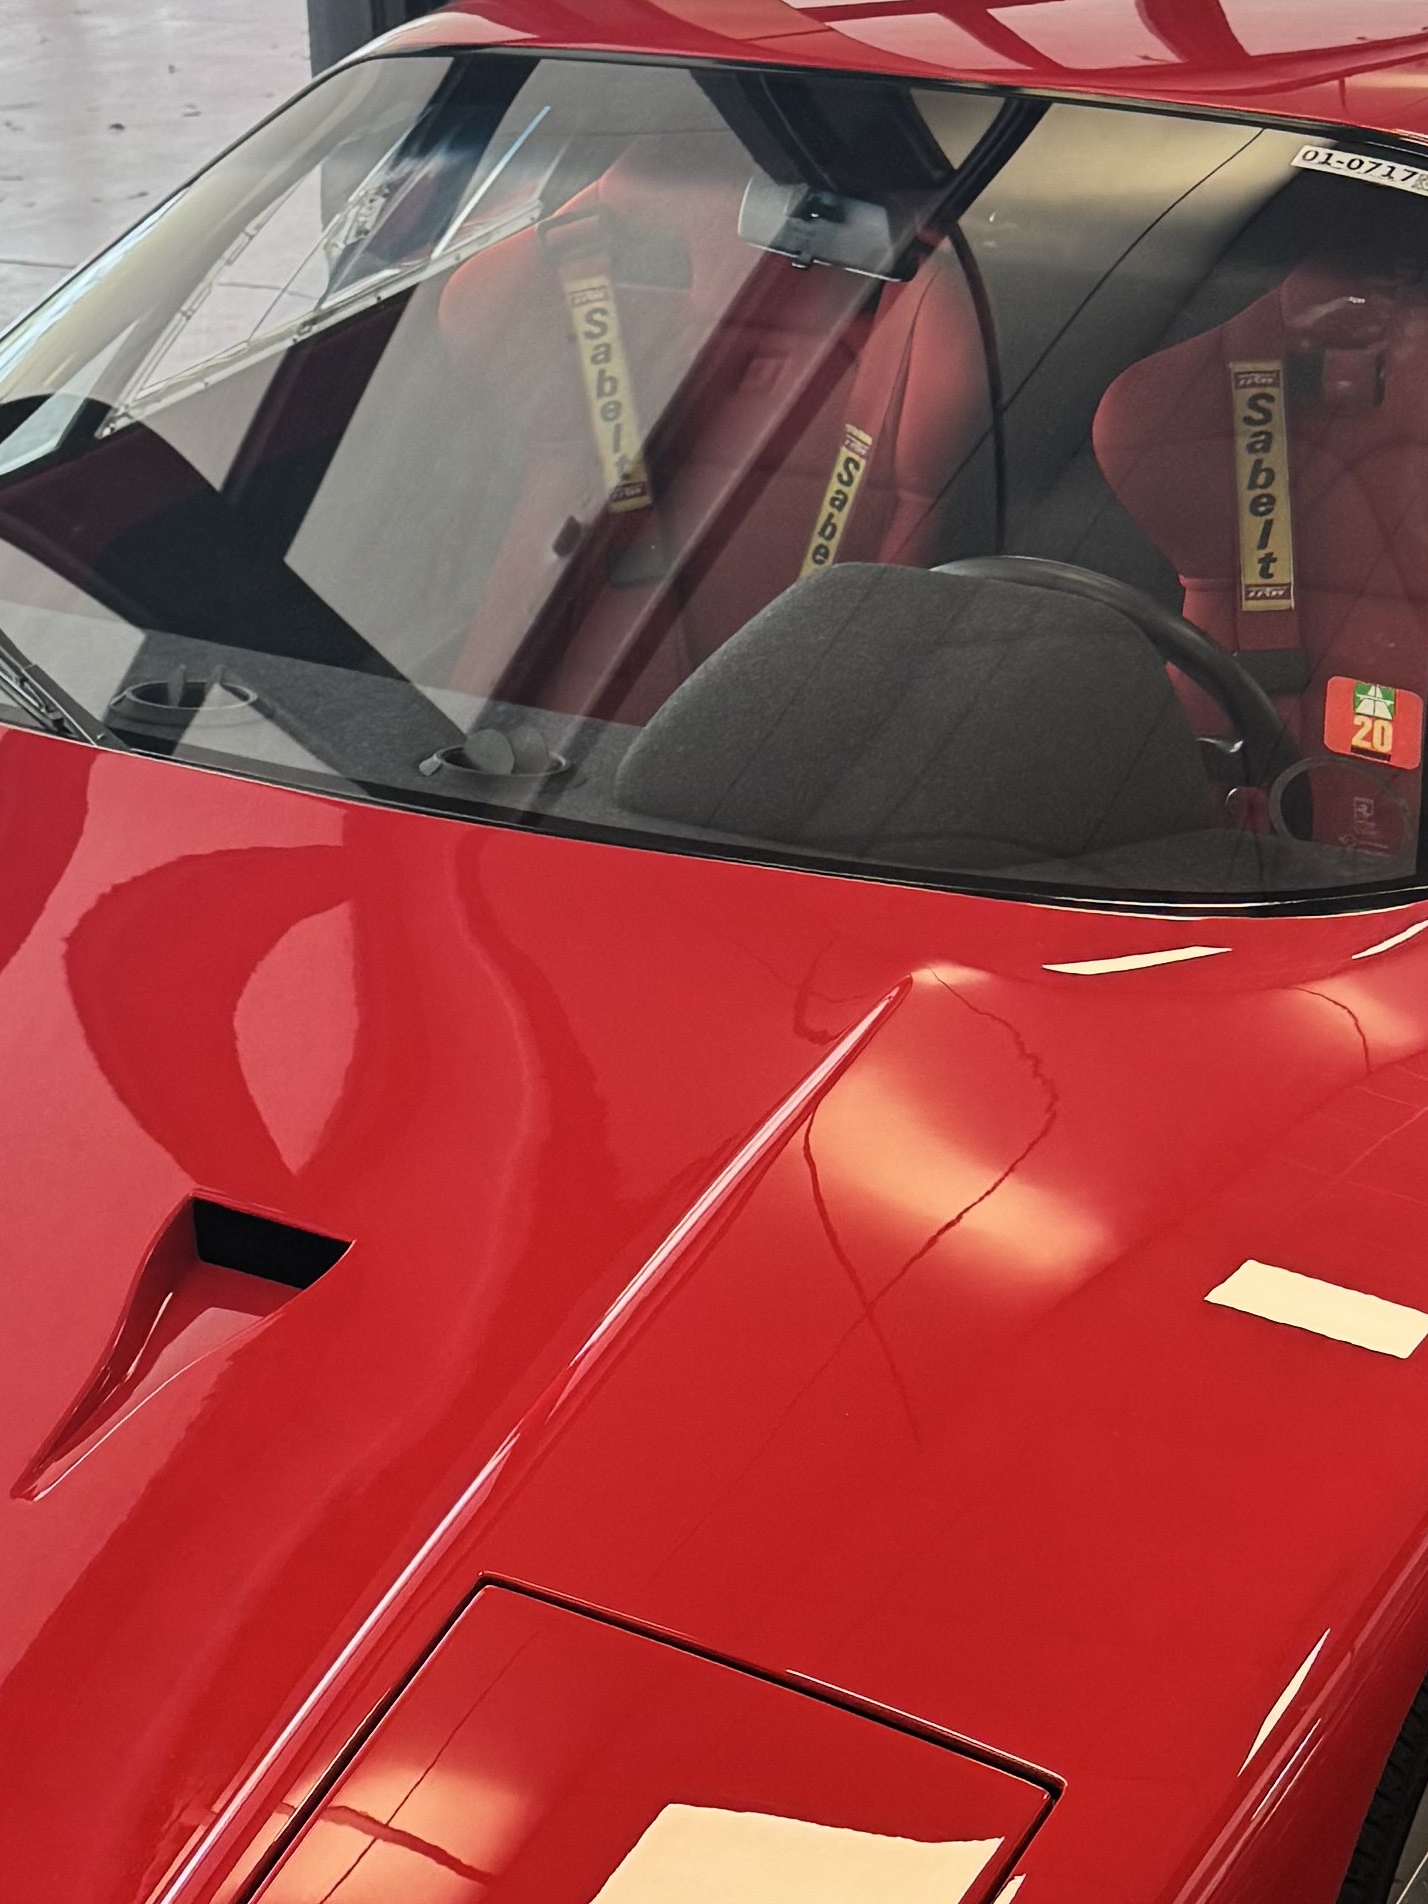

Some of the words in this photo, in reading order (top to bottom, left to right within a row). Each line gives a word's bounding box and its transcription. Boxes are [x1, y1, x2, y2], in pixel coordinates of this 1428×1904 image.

[1302, 149, 1418, 183] 01-0717
[582, 307, 632, 481] Sabelt
[1242, 392, 1278, 580] Sabelt
[1352, 717, 1393, 753] 20
